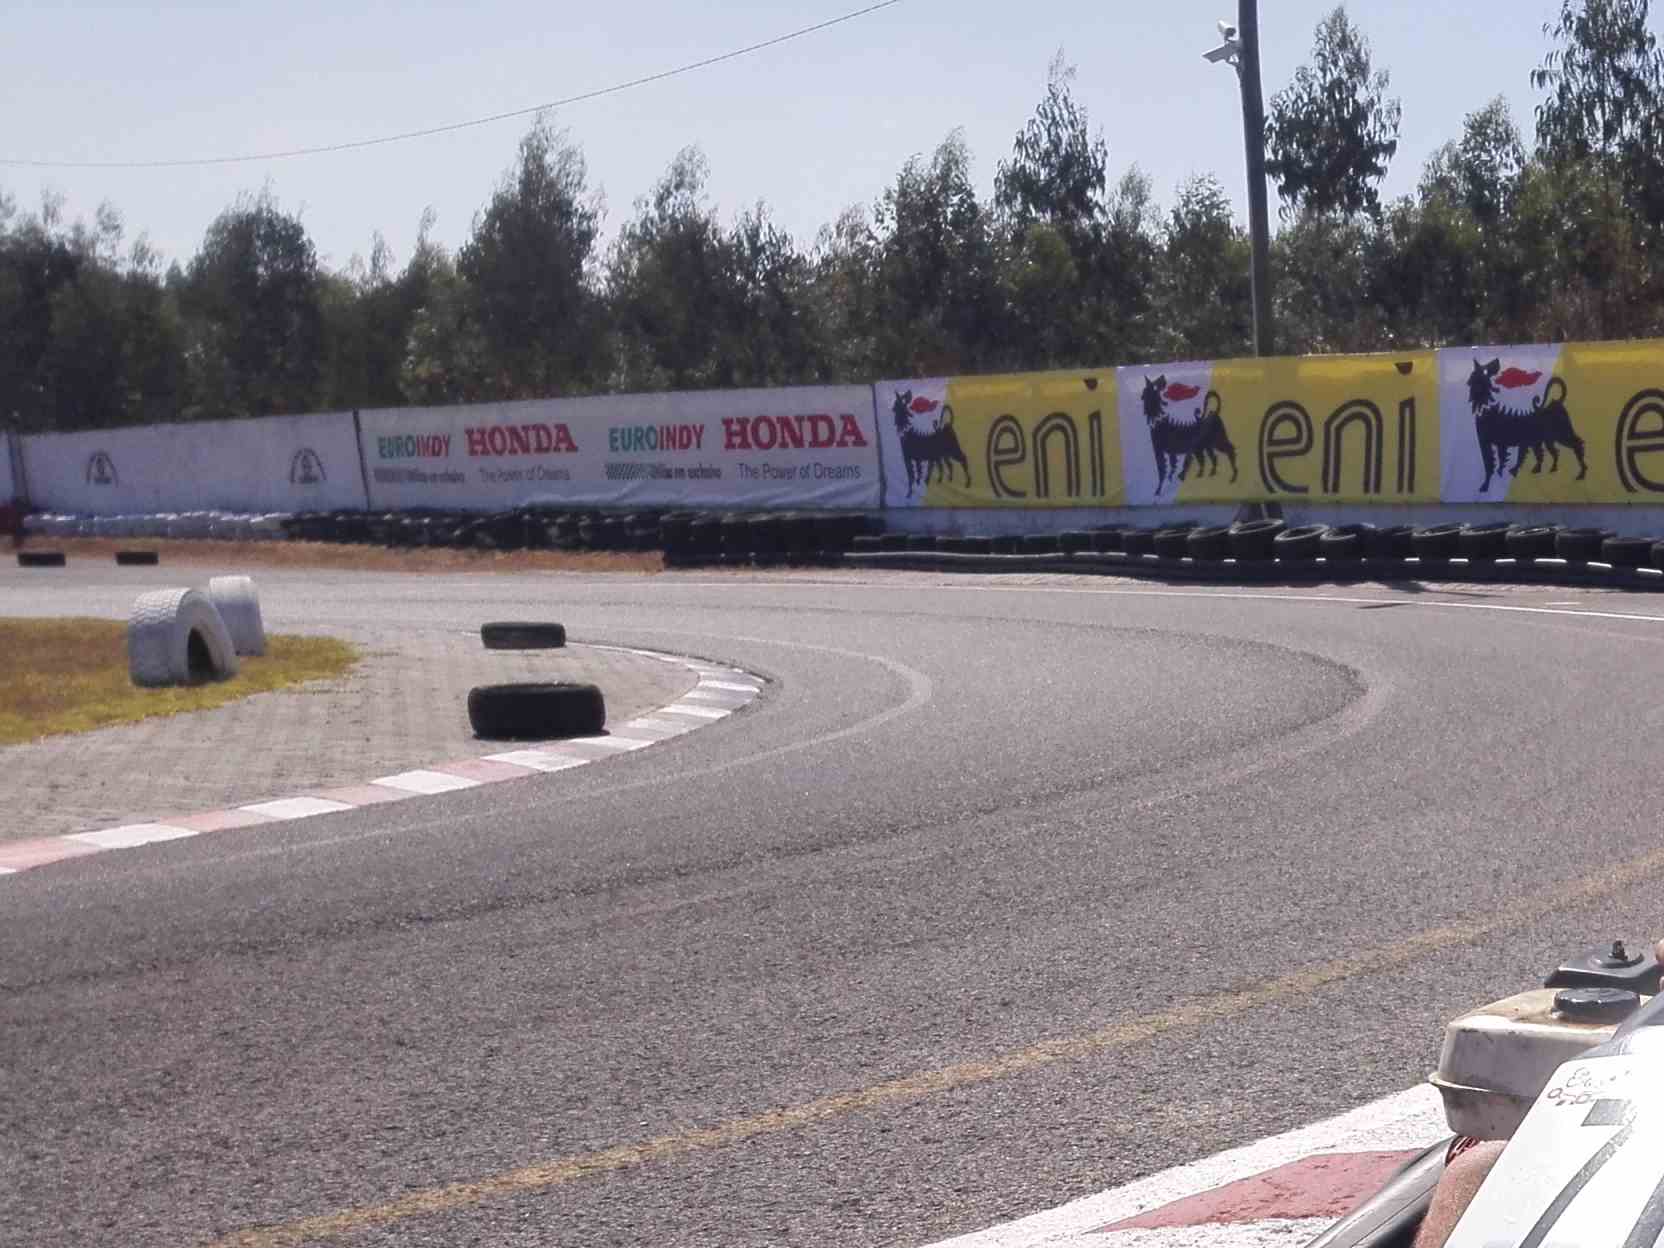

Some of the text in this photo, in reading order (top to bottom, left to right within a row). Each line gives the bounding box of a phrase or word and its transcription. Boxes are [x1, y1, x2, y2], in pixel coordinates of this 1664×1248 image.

[377, 433, 450, 459] EUROINDY
[465, 422, 579, 457] HONDA
[608, 424, 705, 452] EUROINDY
[721, 413, 868, 451] HONDA
[986, 377, 1107, 499] eni
[1257, 361, 1418, 496] eni
[737, 463, 759, 480] The
[762, 463, 796, 480] Power
[799, 462, 812, 480] of
[814, 462, 862, 480] Dreams
